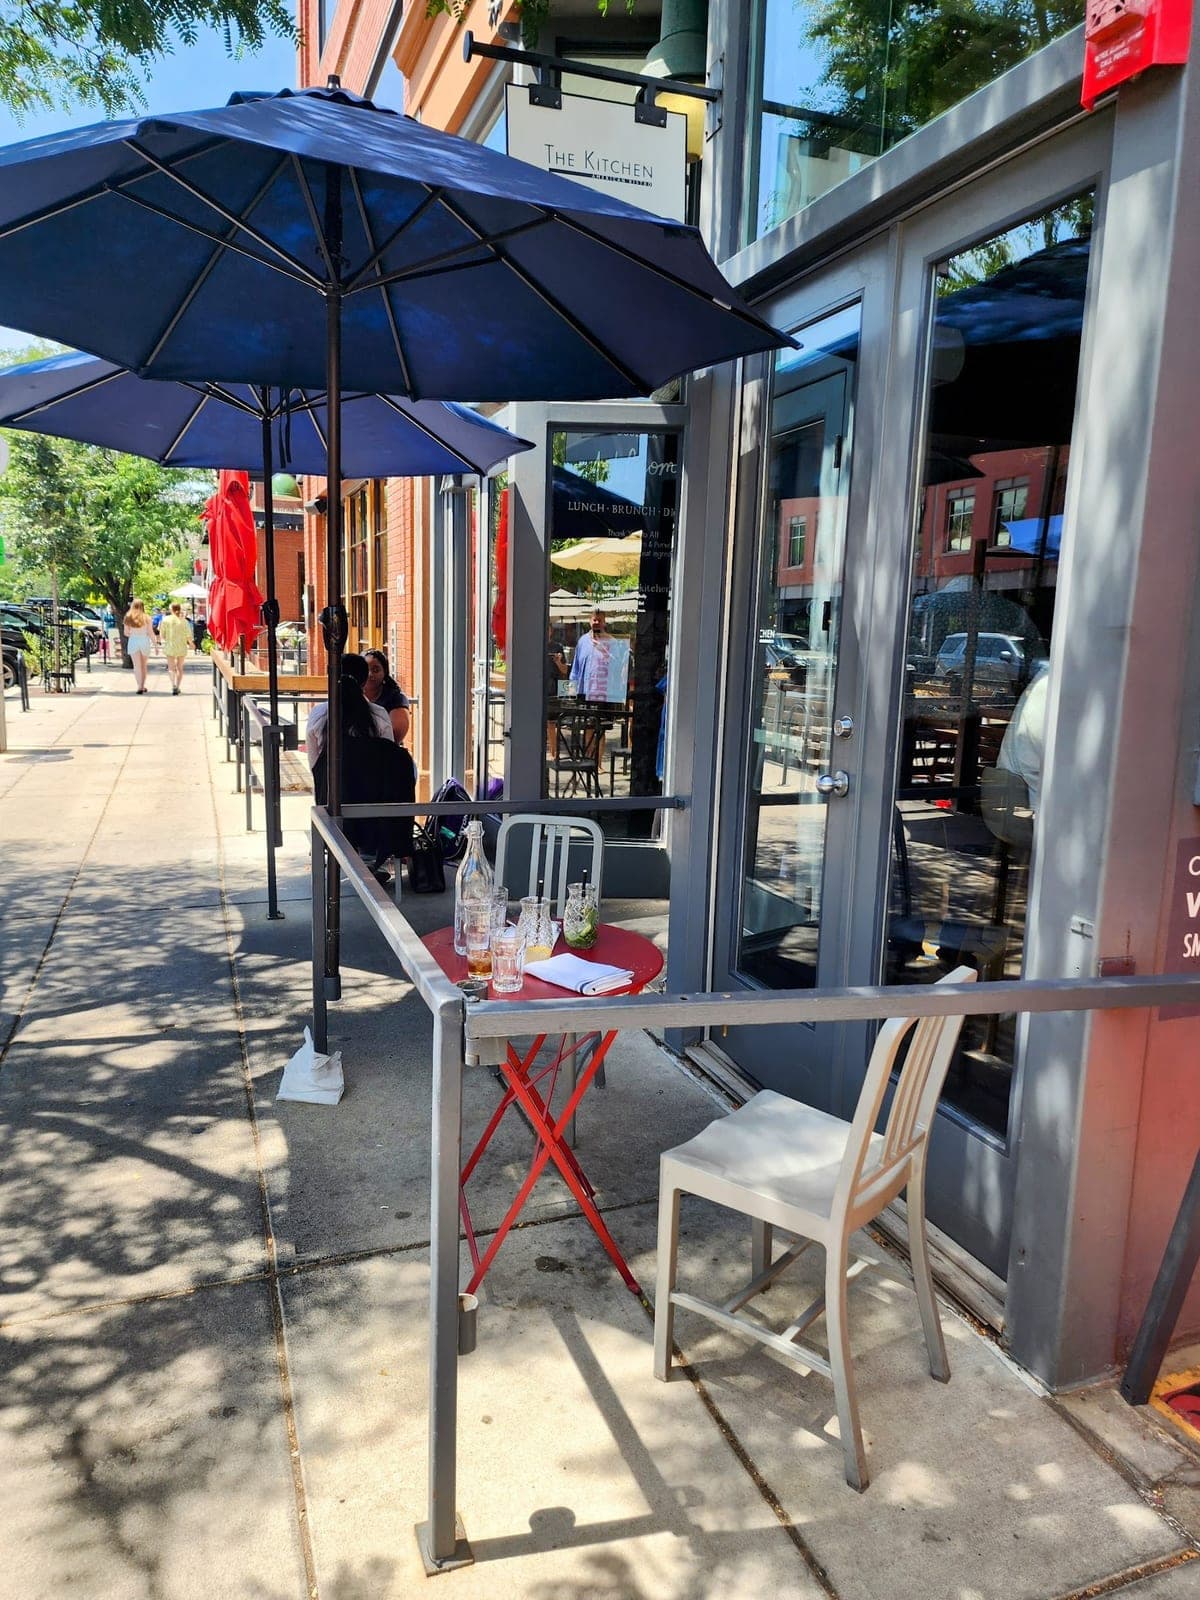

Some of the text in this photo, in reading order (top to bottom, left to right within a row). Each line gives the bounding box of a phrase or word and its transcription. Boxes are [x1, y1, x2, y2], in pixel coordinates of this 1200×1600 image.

[544, 143, 653, 178] THE KITCHEN
[568, 501, 604, 512] LUNCH
[612, 504, 656, 516] BRUNCH
